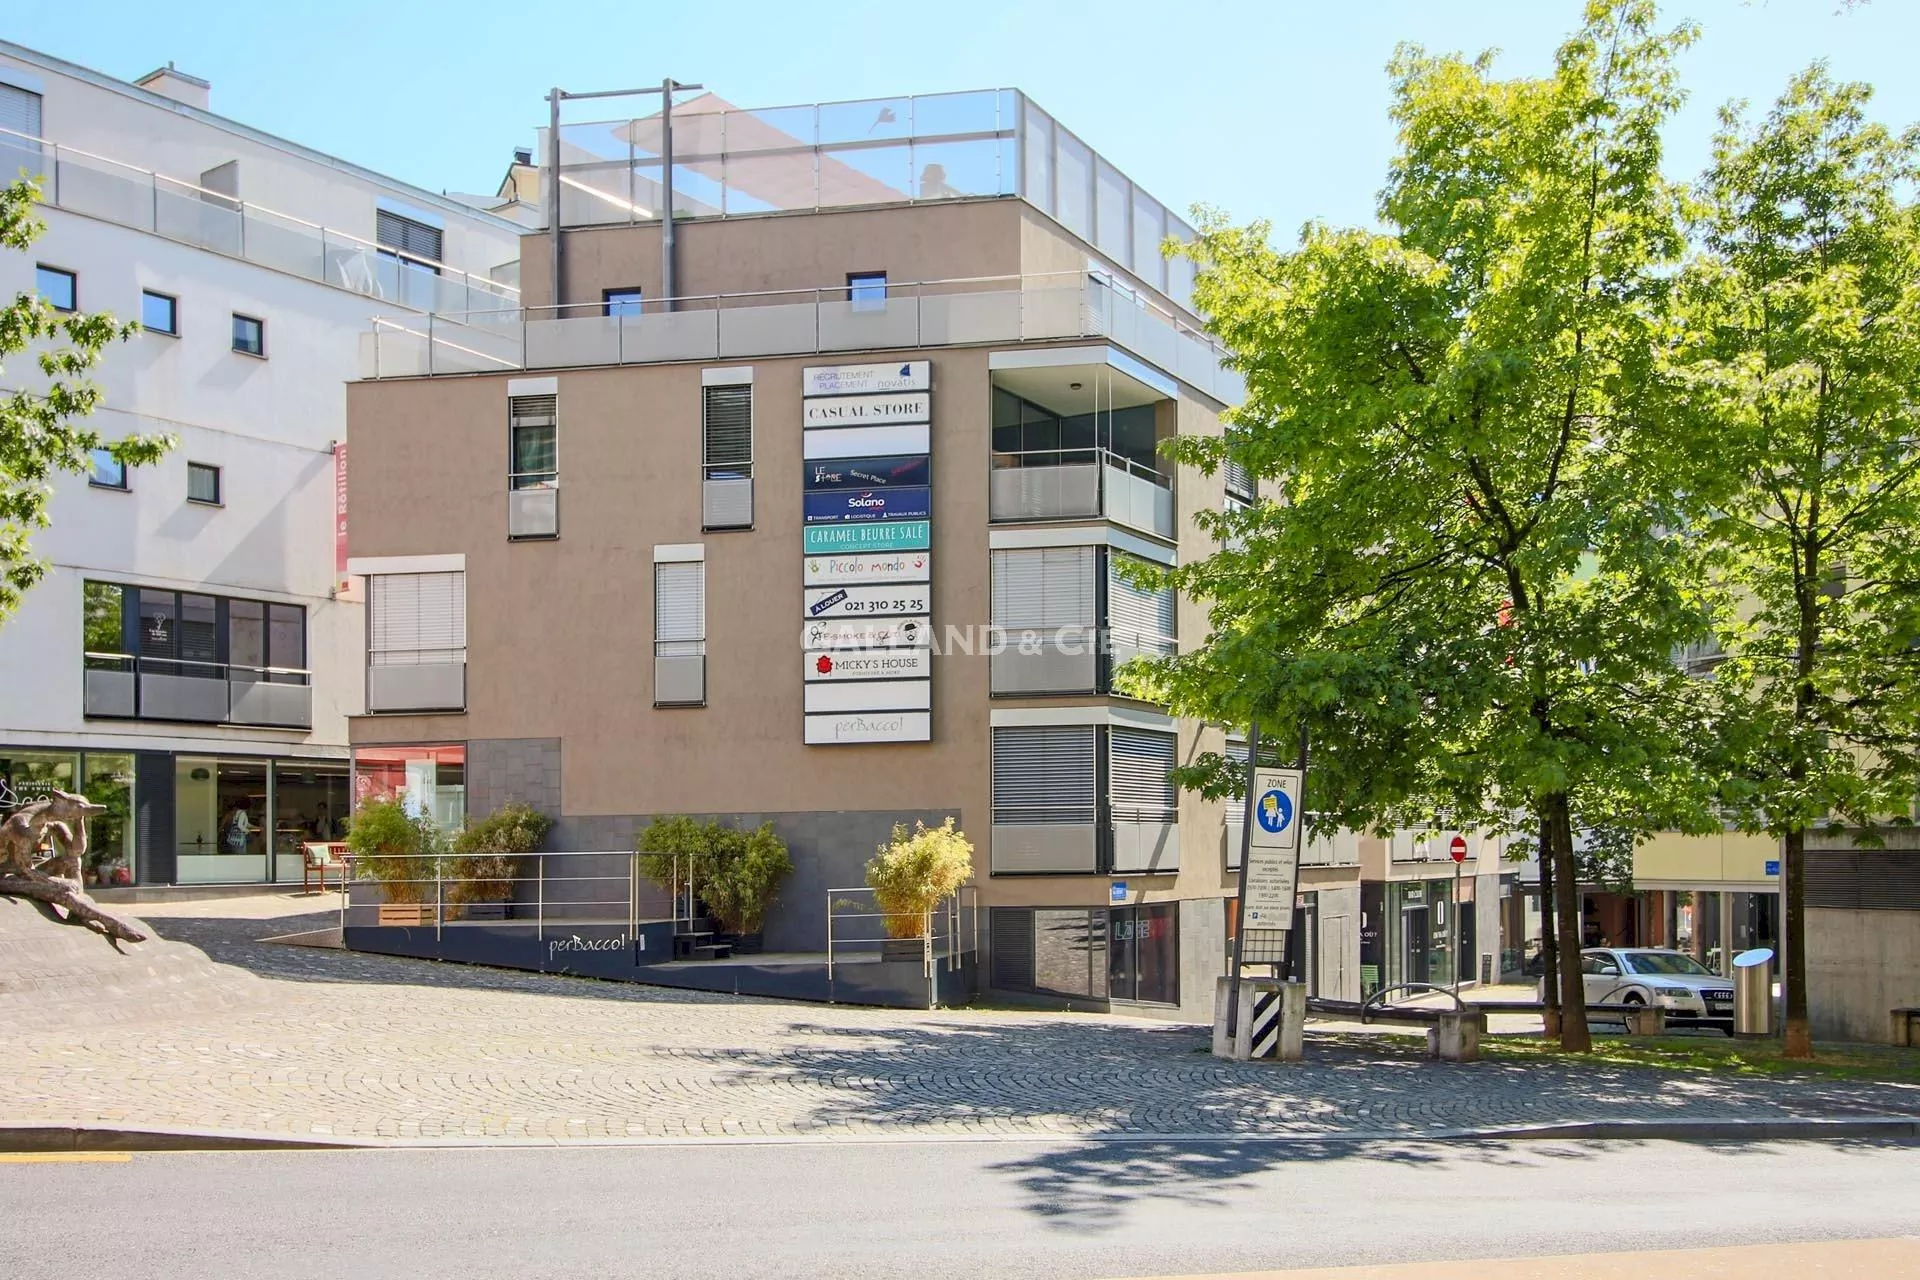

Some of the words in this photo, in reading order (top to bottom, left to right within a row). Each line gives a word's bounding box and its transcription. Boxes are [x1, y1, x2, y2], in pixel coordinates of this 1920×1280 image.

[819, 380, 868, 390] PLACEMENT
[809, 405, 868, 420] CASUAL
[873, 402, 924, 417] STORE
[815, 466, 826, 475] LE
[850, 469, 870, 481] Secret
[870, 475, 887, 485] Place
[848, 498, 885, 508] Solano
[338, 520, 347, 537] le
[810, 529, 857, 544] CARAMEL
[861, 527, 896, 542] BEURRE
[900, 524, 923, 540] SALÉ
[830, 557, 864, 574] Piccolo
[871, 557, 905, 573] mondo
[821, 593, 844, 609] LOUER
[845, 601, 865, 612] 021
[869, 600, 889, 613] 310
[892, 600, 906, 612] 25
[910, 599, 924, 611] 25
[835, 659, 879, 671] MICKY'S
[881, 658, 918, 669] HOUSE
[835, 716, 903, 740] perBacco!
[1267, 778, 1287, 789] ZONE
[549, 933, 625, 961] perBacco!
